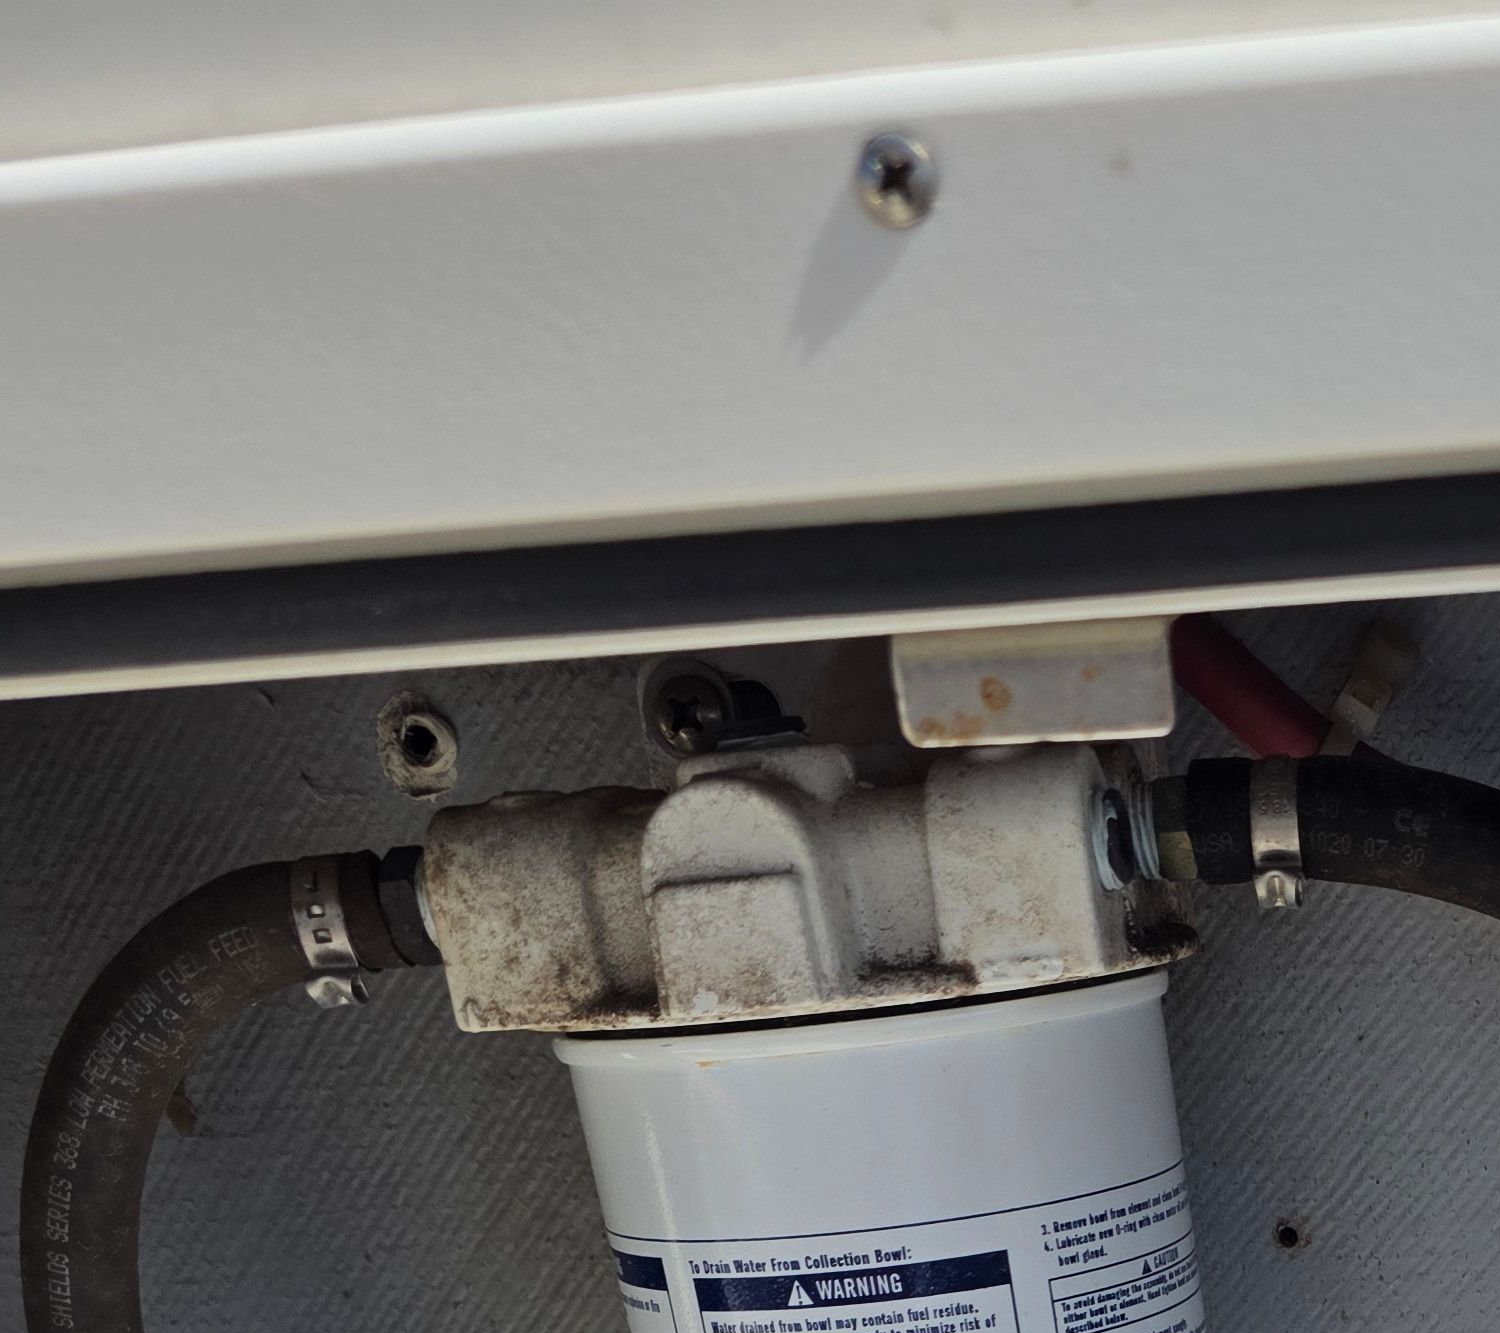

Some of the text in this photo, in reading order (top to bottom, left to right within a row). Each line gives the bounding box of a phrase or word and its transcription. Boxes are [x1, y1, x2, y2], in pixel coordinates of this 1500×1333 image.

[45, 925, 259, 1327] SHIELDS SERIES 368 LOW PERMEATION FUEL FEED
[688, 1247, 911, 1274] To Drain Water From Collection Bowl:
[815, 1273, 902, 1299] WARNING
[710, 1321, 736, 1333] Water
[778, 1319, 803, 1333] from
[804, 1317, 832, 1331] bowl
[835, 1317, 857, 1331] may
[861, 1311, 904, 1327] contain
[906, 1306, 929, 1322] fuel
[933, 1302, 979, 1318] residue.
[959, 1316, 981, 1332] risk
[984, 1313, 996, 1328] of
